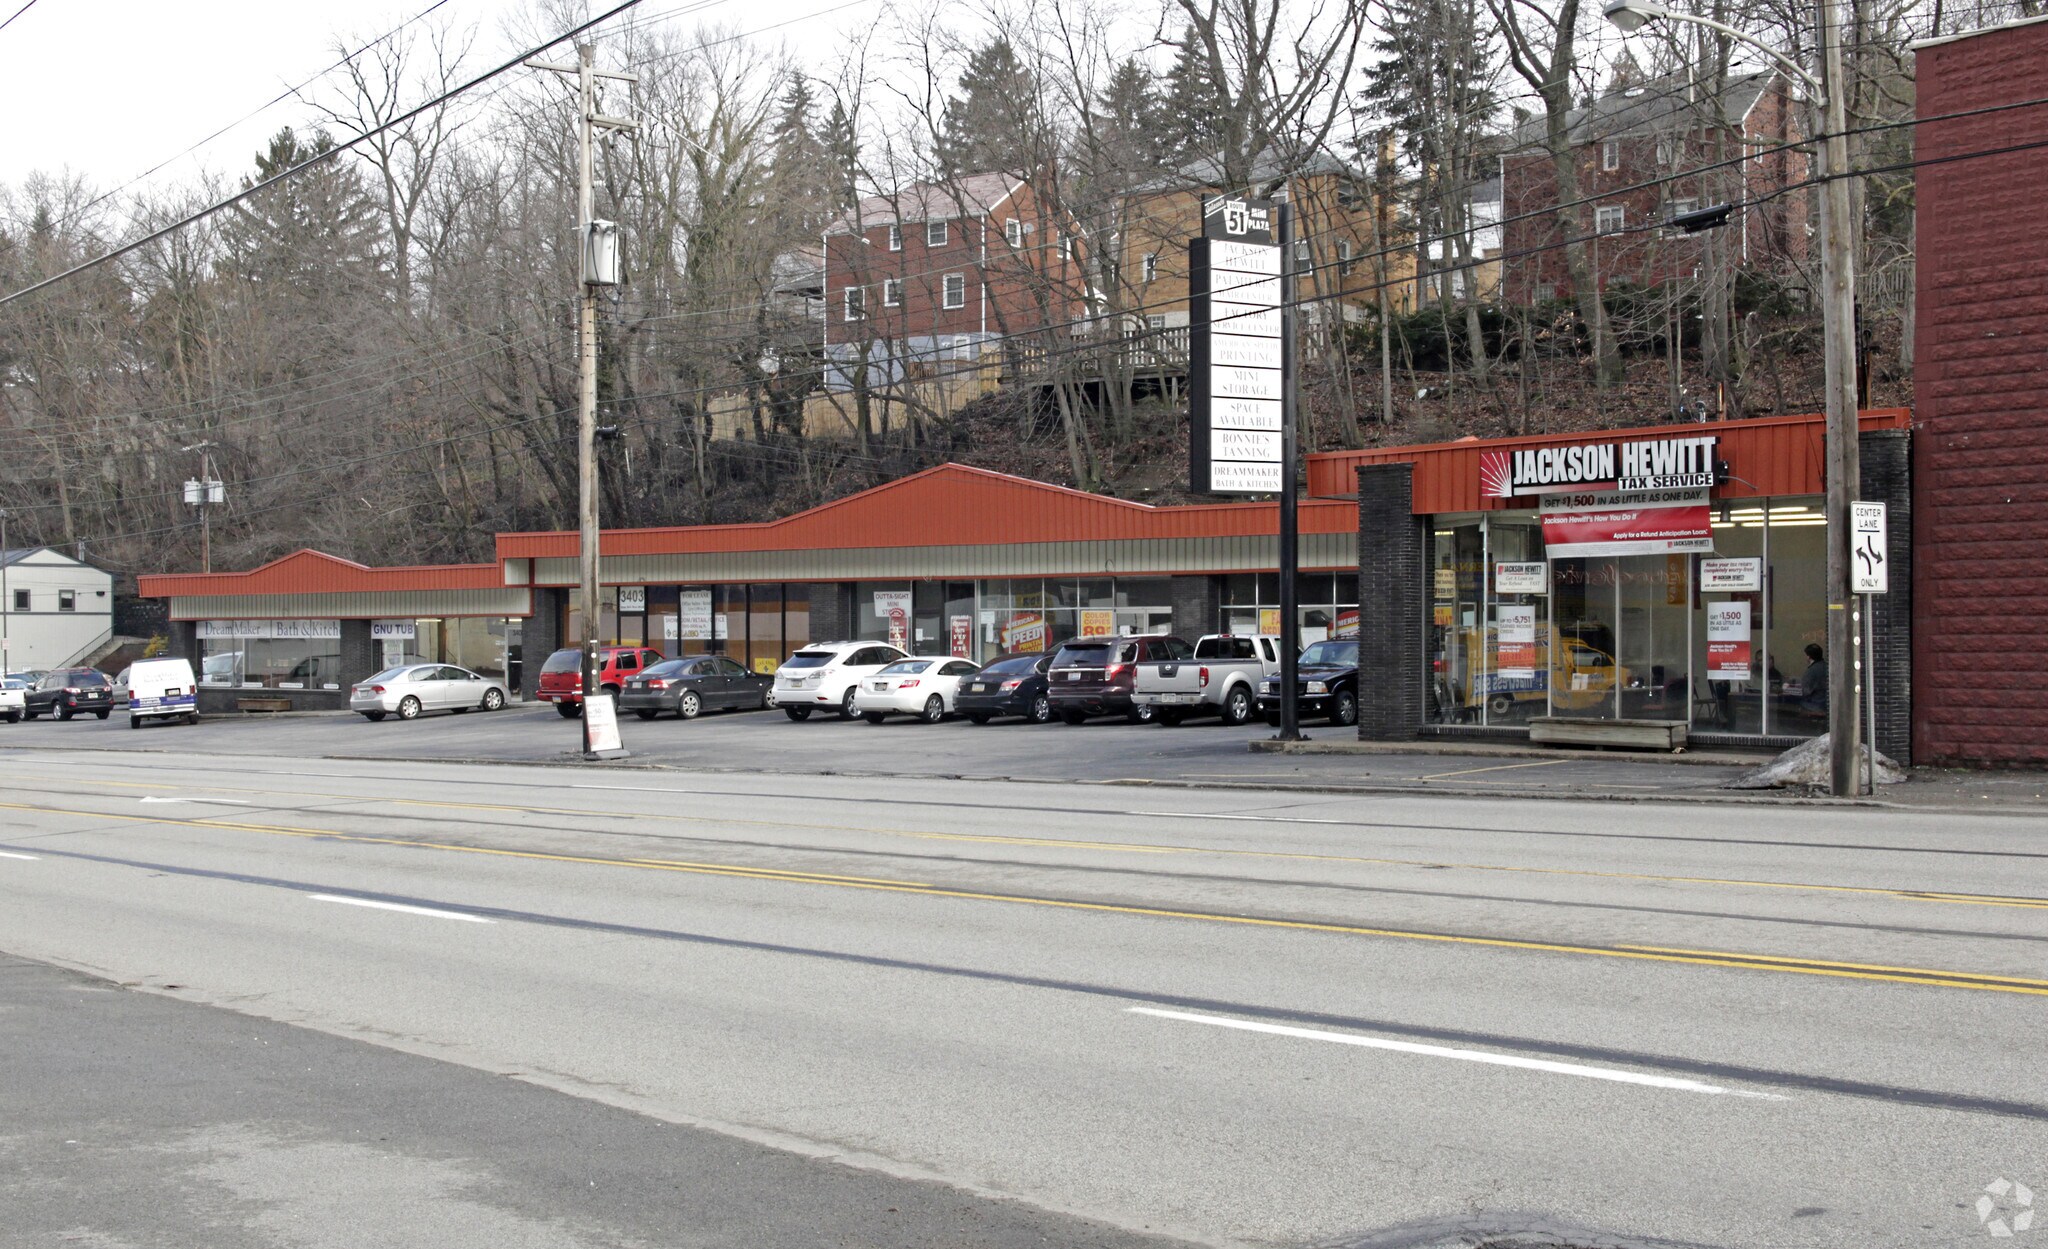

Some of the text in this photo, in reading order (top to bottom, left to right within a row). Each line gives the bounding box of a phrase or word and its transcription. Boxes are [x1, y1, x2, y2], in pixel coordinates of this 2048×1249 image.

[1229, 210, 1245, 232] 51
[1248, 219, 1270, 231] PLAZA
[1223, 384, 1268, 395] STORAGE
[1230, 403, 1261, 414] SPACE
[1220, 415, 1273, 427] AVAILABLE
[1222, 433, 1270, 445] BONNIE'S
[1223, 446, 1270, 458] TANNING
[1514, 437, 1716, 485] JACKSON HEWITT
[1214, 466, 1279, 477] DREAMMAKER
[1215, 480, 1235, 488] BATH
[1247, 480, 1279, 488] KITCHEN
[1620, 473, 1713, 490] TAX SERVICE
[1545, 490, 1703, 509] GET $1,500 IN AS LITTLE AS ONE DAY.
[1855, 508, 1882, 517] CENTER
[1544, 516, 1568, 525] Jackson
[1569, 514, 1593, 523] Hewitt's
[1594, 514, 1608, 522] How
[1610, 513, 1621, 521] You
[1622, 513, 1631, 521] Do
[1859, 519, 1878, 528] LANE
[1613, 532, 1628, 540] Apply
[1659, 530, 1691, 538] Anticipation
[1504, 565, 1542, 573] JACKSON HEWITT
[1861, 578, 1879, 588] ONLY
[620, 590, 644, 603] 3403
[277, 621, 299, 636] Bath
[300, 622, 310, 636] &
[374, 624, 413, 634] GNU TUB
